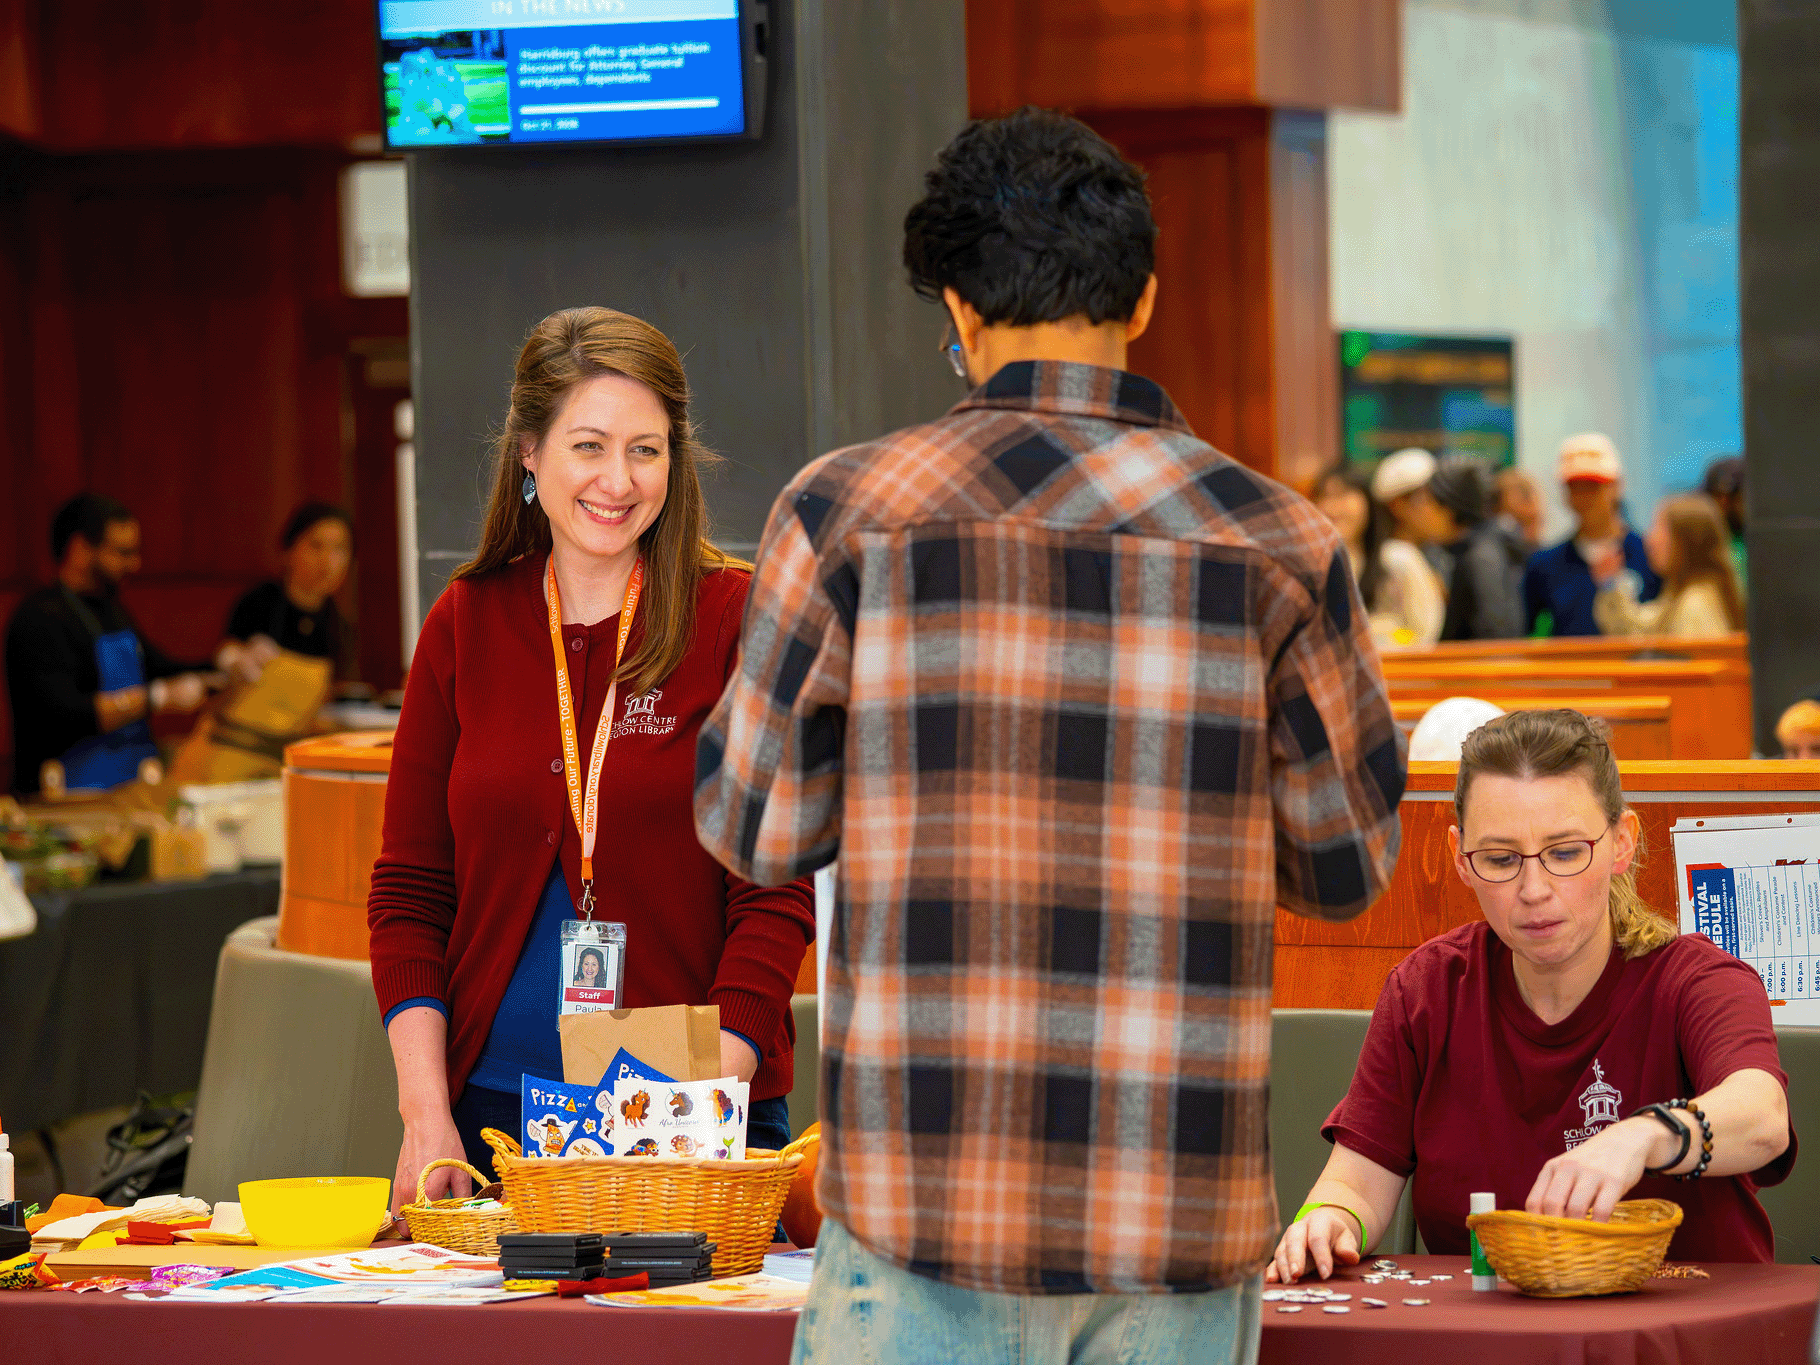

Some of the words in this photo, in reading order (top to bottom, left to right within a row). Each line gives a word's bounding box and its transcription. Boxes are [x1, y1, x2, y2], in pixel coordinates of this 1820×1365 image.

[521, 0, 557, 14] THE
[624, 582, 640, 616] Future
[558, 667, 570, 722] TOGETHER
[640, 715, 677, 725] CENTRE
[565, 729, 576, 764] Future
[568, 766, 578, 786] Our
[1697, 882, 1710, 939] STIVAL
[1710, 894, 1723, 949] EDULE
[1564, 1125, 1602, 1139] SCHLOW
